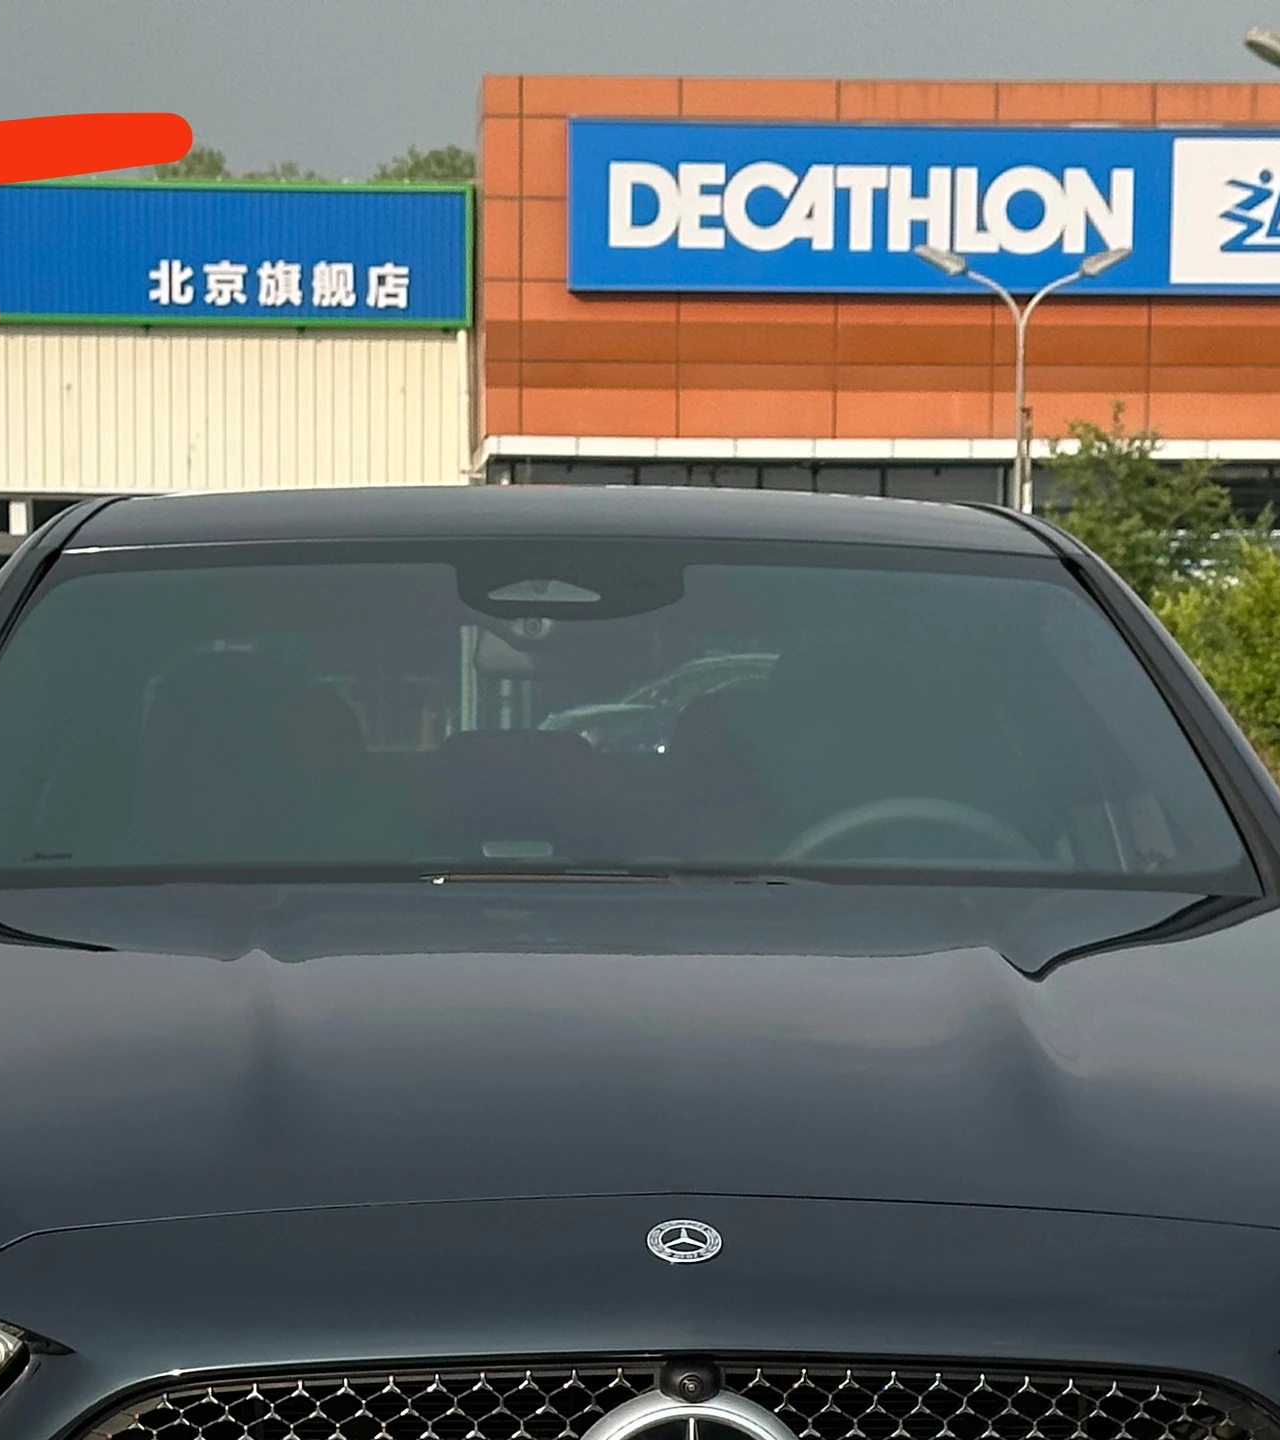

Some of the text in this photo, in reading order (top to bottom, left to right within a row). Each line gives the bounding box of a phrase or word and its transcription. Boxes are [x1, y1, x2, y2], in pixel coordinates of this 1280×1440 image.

[609, 160, 1135, 254] DECATHLON
[148, 259, 410, 309] 北京旗舰店
